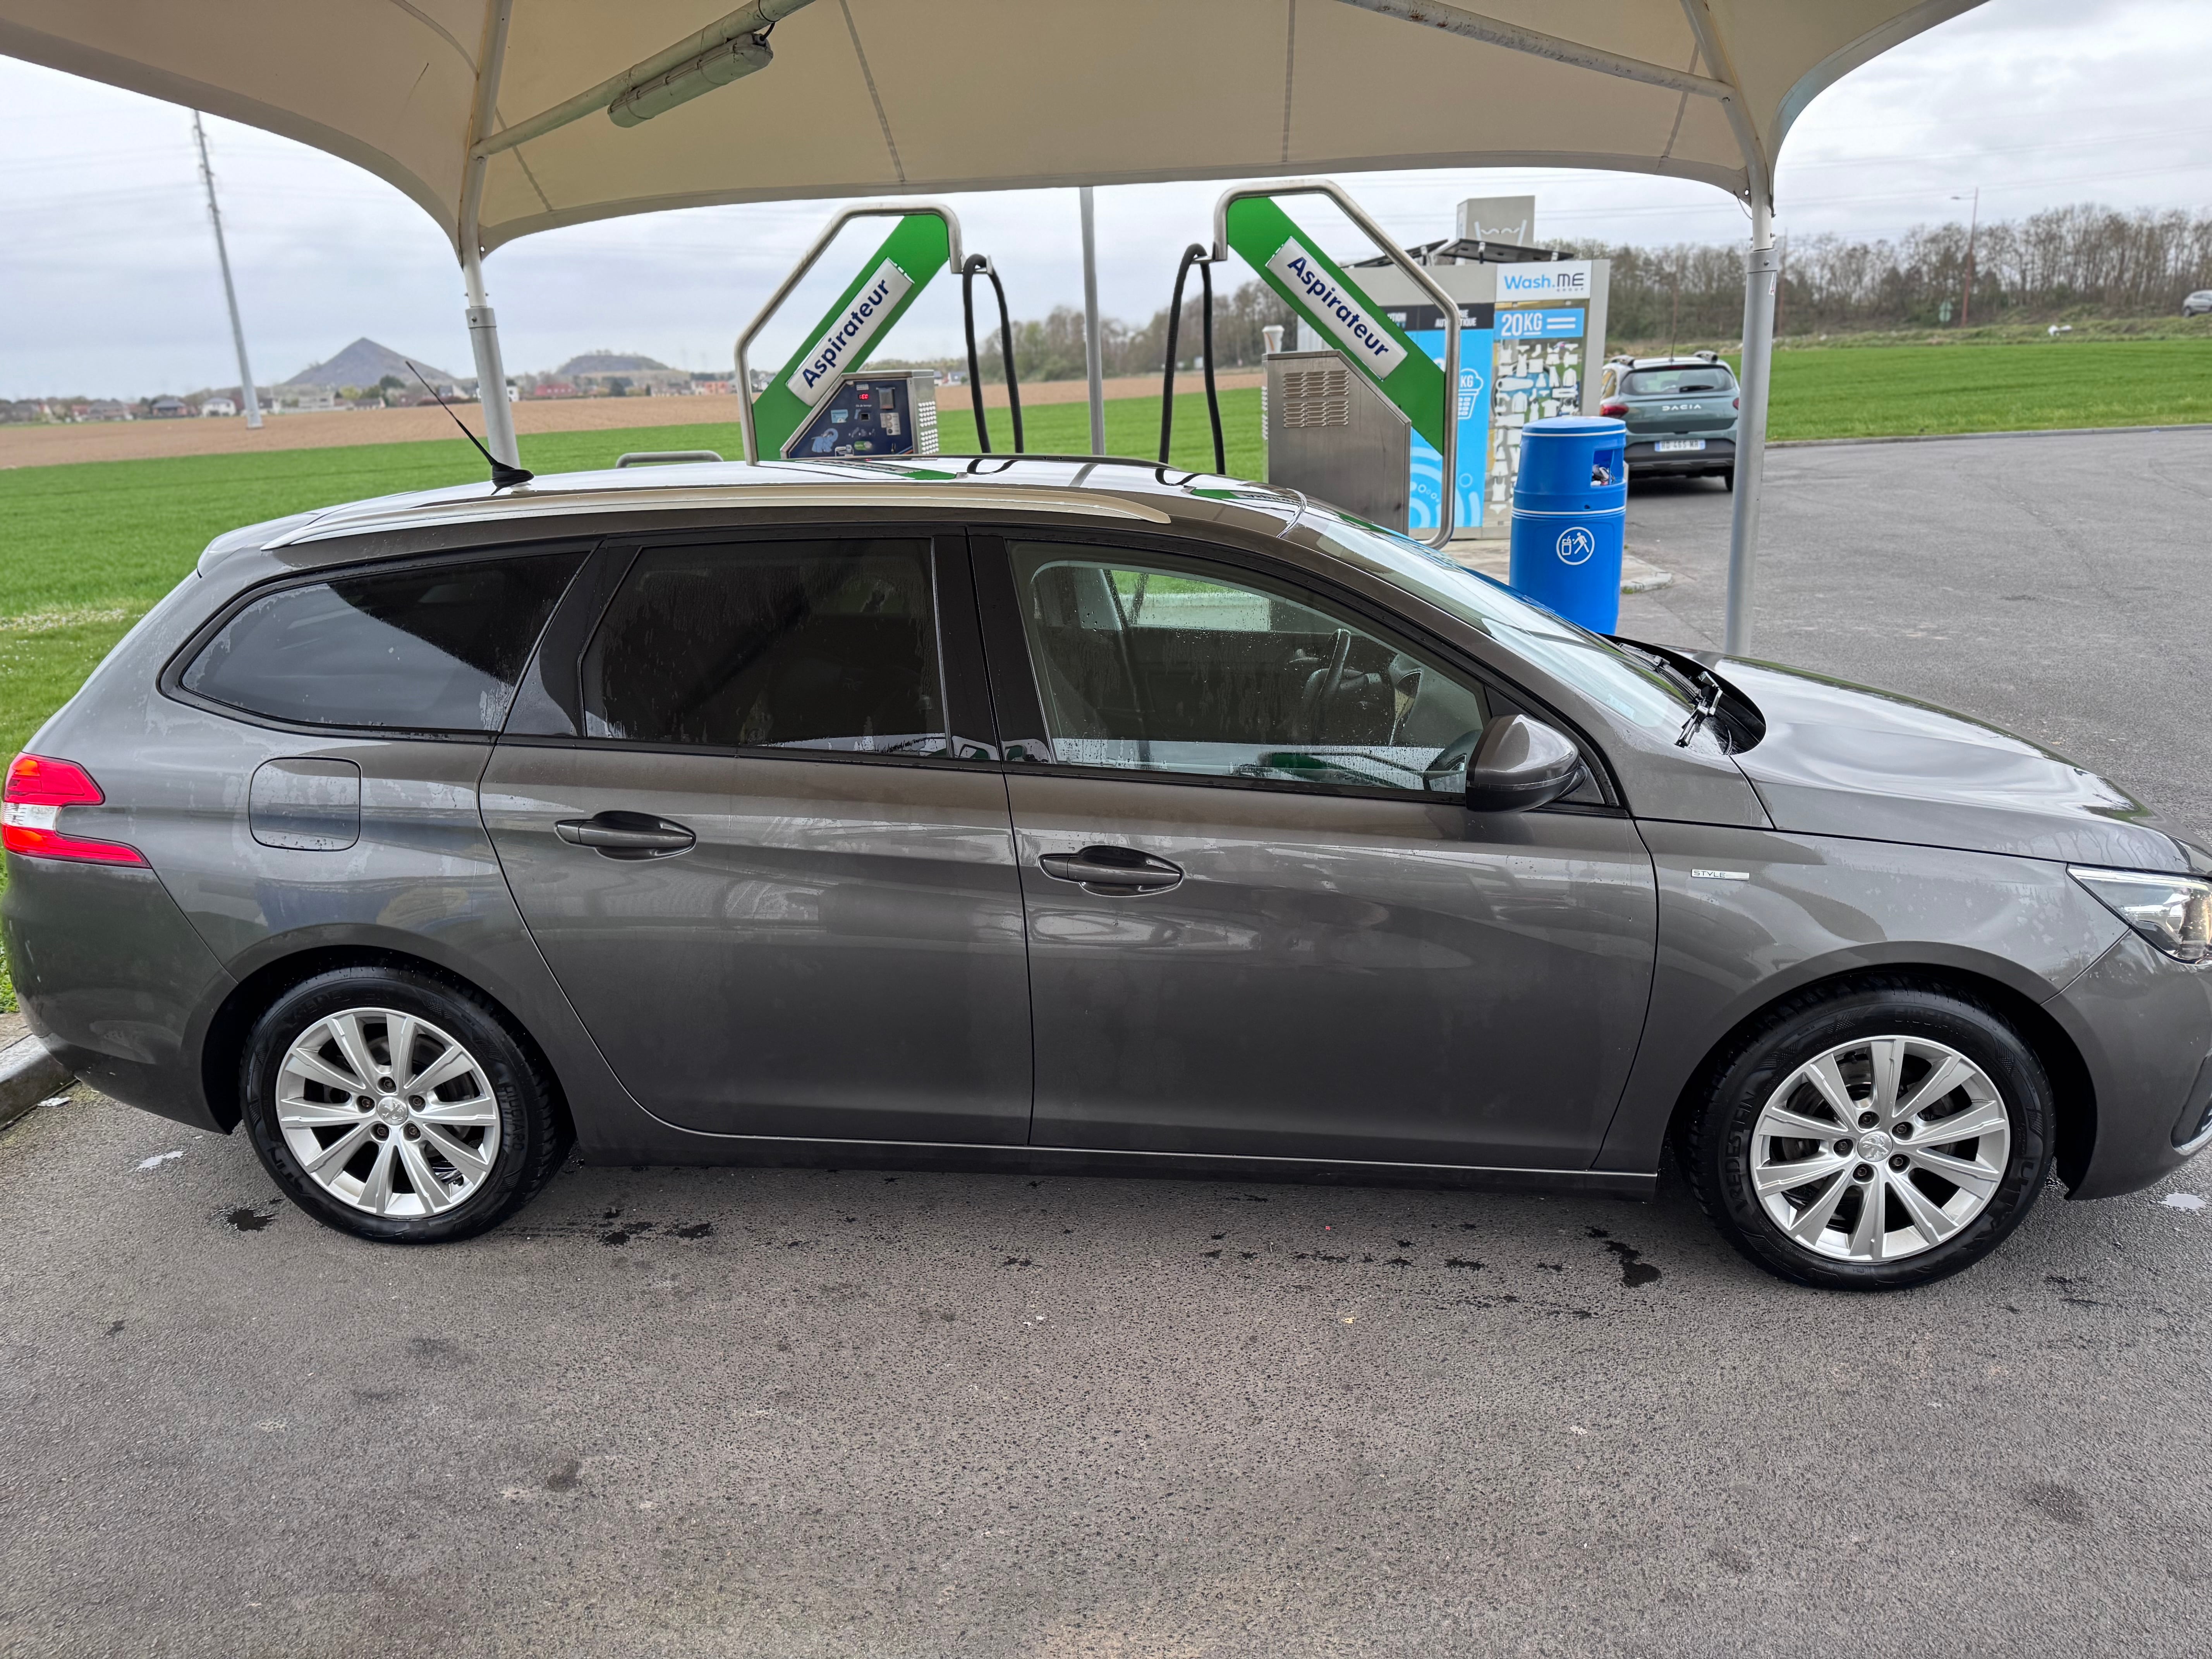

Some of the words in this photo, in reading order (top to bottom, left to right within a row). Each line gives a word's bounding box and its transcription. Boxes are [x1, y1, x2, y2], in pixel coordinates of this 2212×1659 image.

[1287, 257, 1389, 356] Aspirateur
[1504, 273, 1584, 289] Wash.ME
[802, 279, 889, 389] Aspirateur
[1434, 318, 1477, 327] AUTTIQUE
